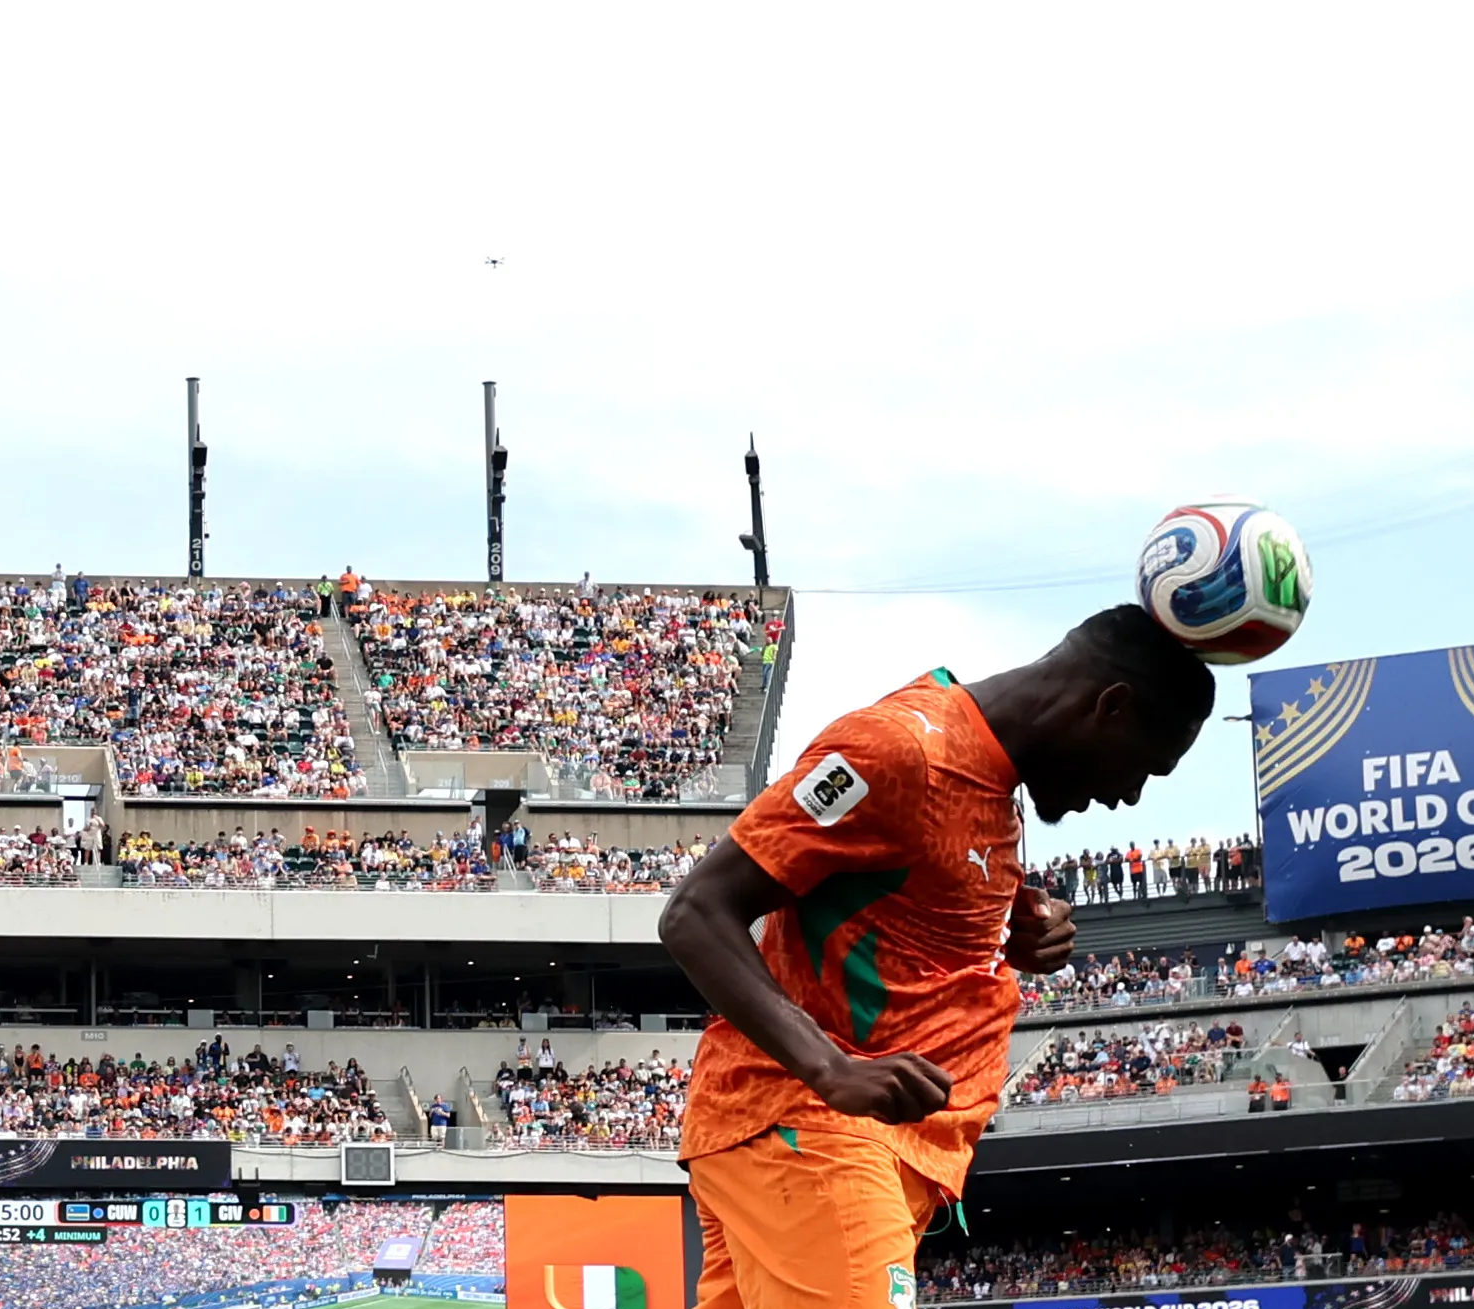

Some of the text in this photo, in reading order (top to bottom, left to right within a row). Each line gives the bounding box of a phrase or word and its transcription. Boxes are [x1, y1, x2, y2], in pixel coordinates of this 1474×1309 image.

[191, 538, 202, 571] 210
[491, 542, 501, 575] 209
[1363, 749, 1461, 791] FIFA
[1288, 796, 1448, 845] WORLD
[71, 1155, 199, 1170] PHILADELPHIA
[107, 1204, 138, 1221] CUW
[148, 1206, 159, 1221] 0
[194, 1206, 203, 1221] 1
[218, 1204, 243, 1221] CIV
[26, 1228, 46, 1242] +4
[54, 1231, 101, 1241] MINIMUM
